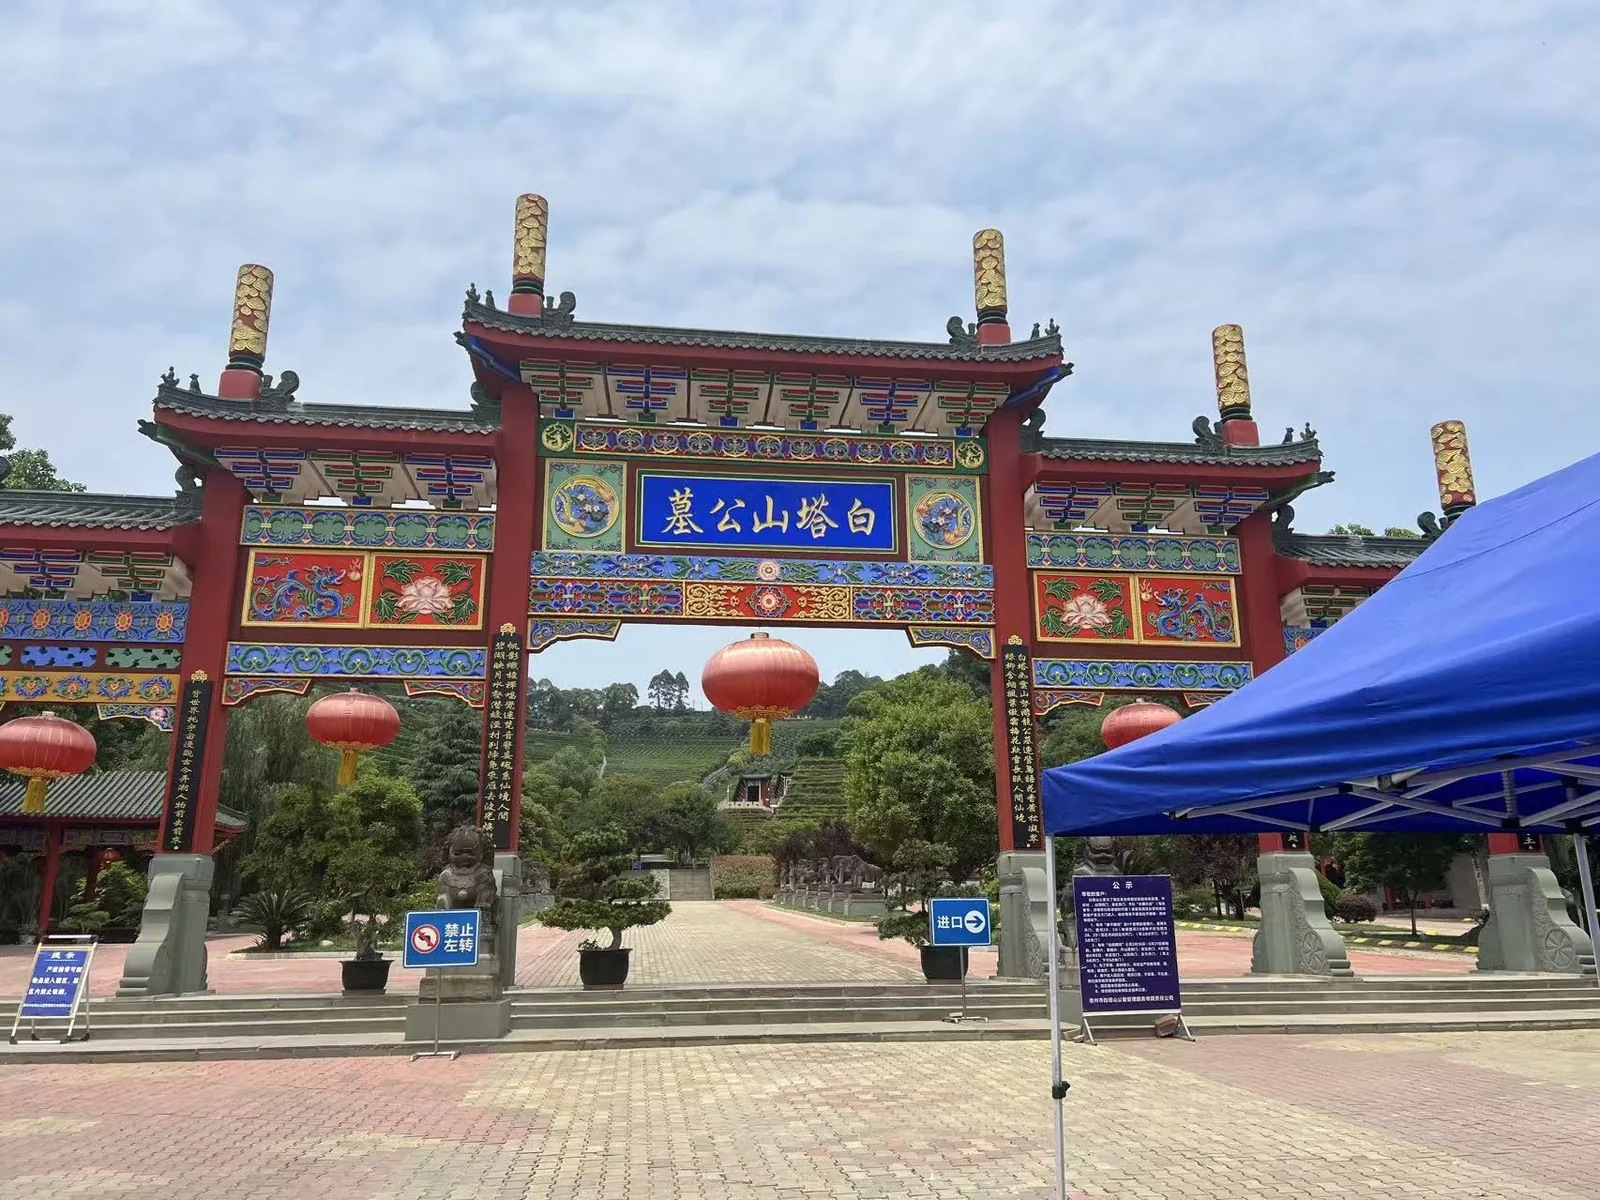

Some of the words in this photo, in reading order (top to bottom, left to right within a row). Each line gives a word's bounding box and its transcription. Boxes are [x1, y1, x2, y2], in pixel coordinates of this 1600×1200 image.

[660, 487, 876, 539] 白塔山公墓
[1112, 881, 1133, 889] 公示
[937, 915, 963, 929] 进口
[444, 922, 475, 938] 禁止
[444, 938, 474, 953] 左转
